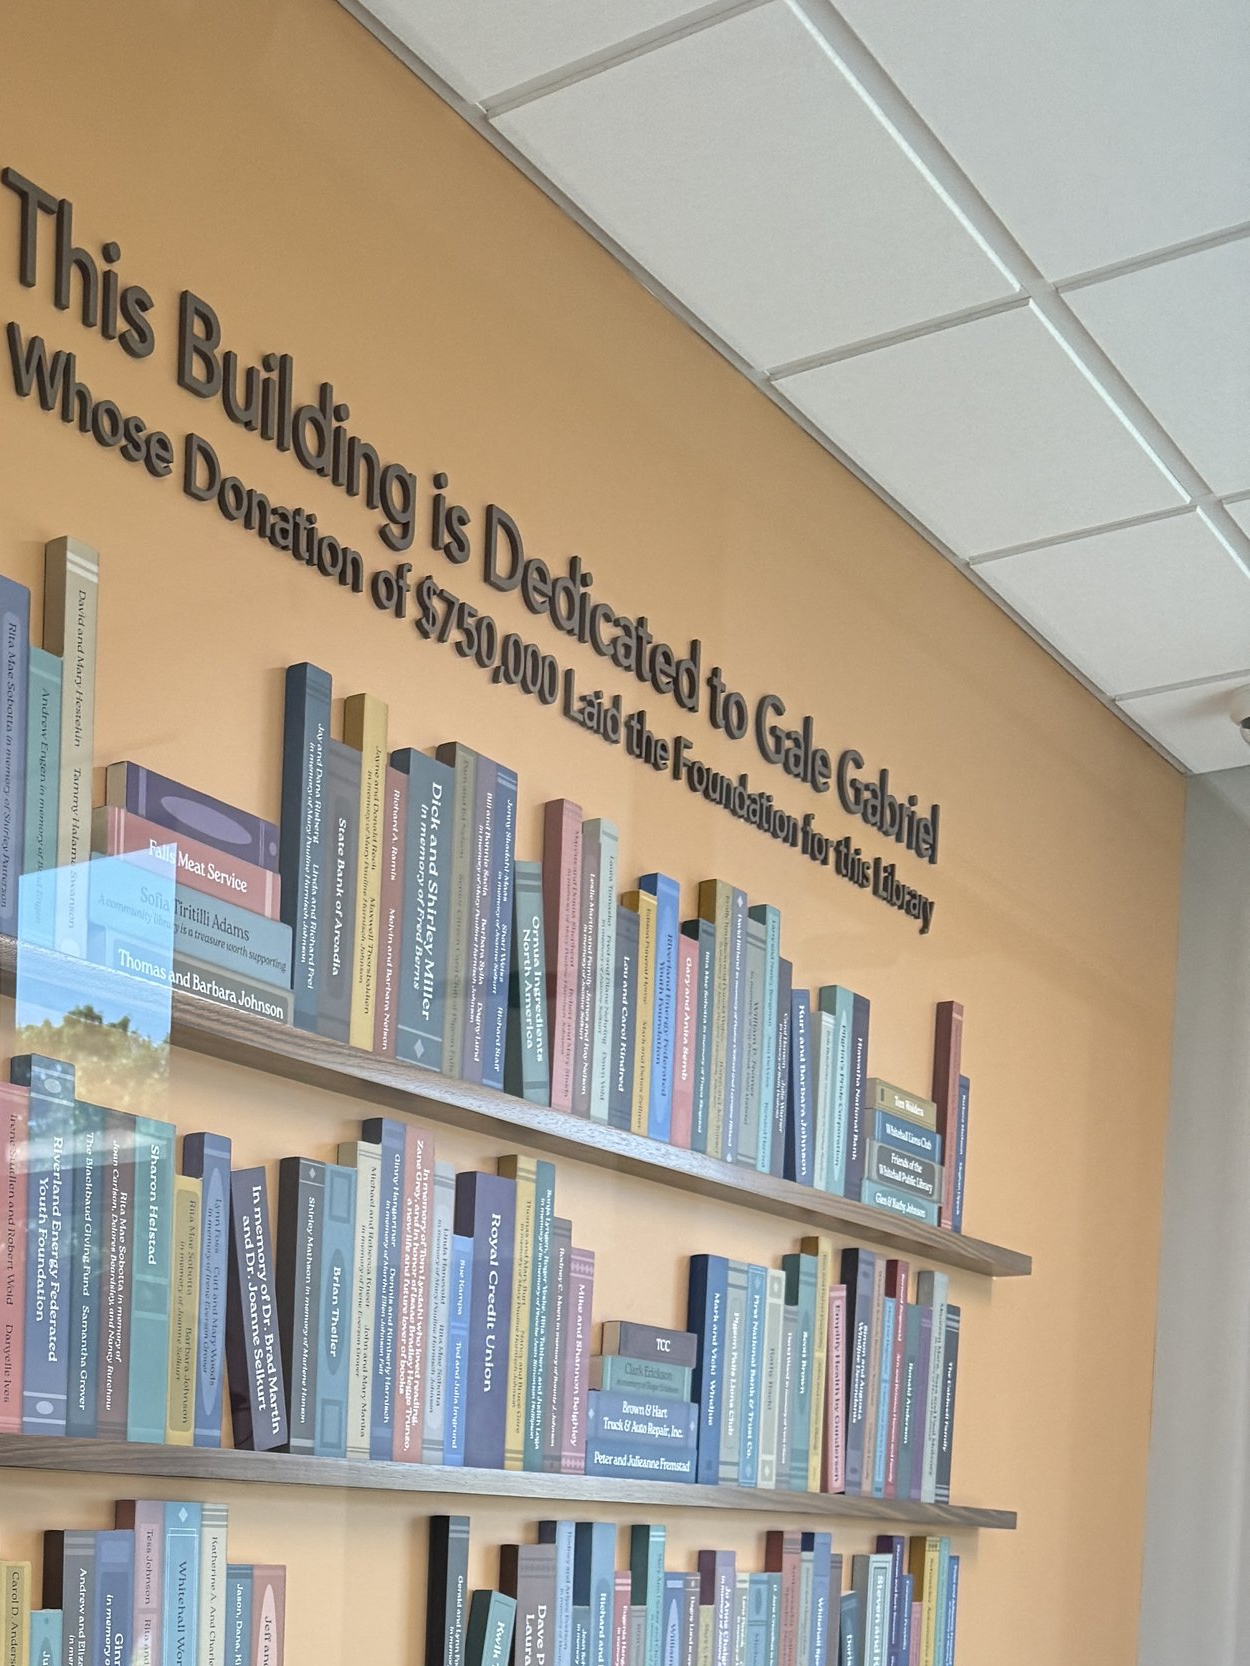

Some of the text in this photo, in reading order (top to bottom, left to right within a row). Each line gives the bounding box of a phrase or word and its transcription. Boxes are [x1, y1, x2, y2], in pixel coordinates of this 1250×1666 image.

[1, 167, 939, 863] This Building is Dedicated to Gale Gabriel
[7, 322, 935, 935] Whose Donation of $750,000 Laid the Foundation for this Library
[73, 589, 86, 747] David and Mary Hestekin
[149, 839, 247, 892] Falls Meat Service
[421, 781, 442, 1020] Dick and Shirley Miller
[118, 949, 284, 1019] Thomas and Barbara Johnson
[522, 928, 533, 1049] North America
[531, 915, 543, 1062] Ornua Ingredients
[855, 1037, 863, 1087] Hiawatha
[35, 1177, 49, 1321] Youth Foundation
[47, 1136, 64, 1362] Riverland Energy Federated
[147, 1144, 159, 1265] Sharon Helstad
[241, 1215, 266, 1411] and Dr. Joanne Selkurt
[251, 1185, 280, 1434] In memory of Dr. Brad Martin
[482, 1213, 501, 1392] Royal Credit Union
[655, 1337, 671, 1352] TCC
[621, 1400, 668, 1418] Brown & Hart
[176, 1561, 187, 1632] Whitehall
[492, 1621, 505, 1658] Kwik
